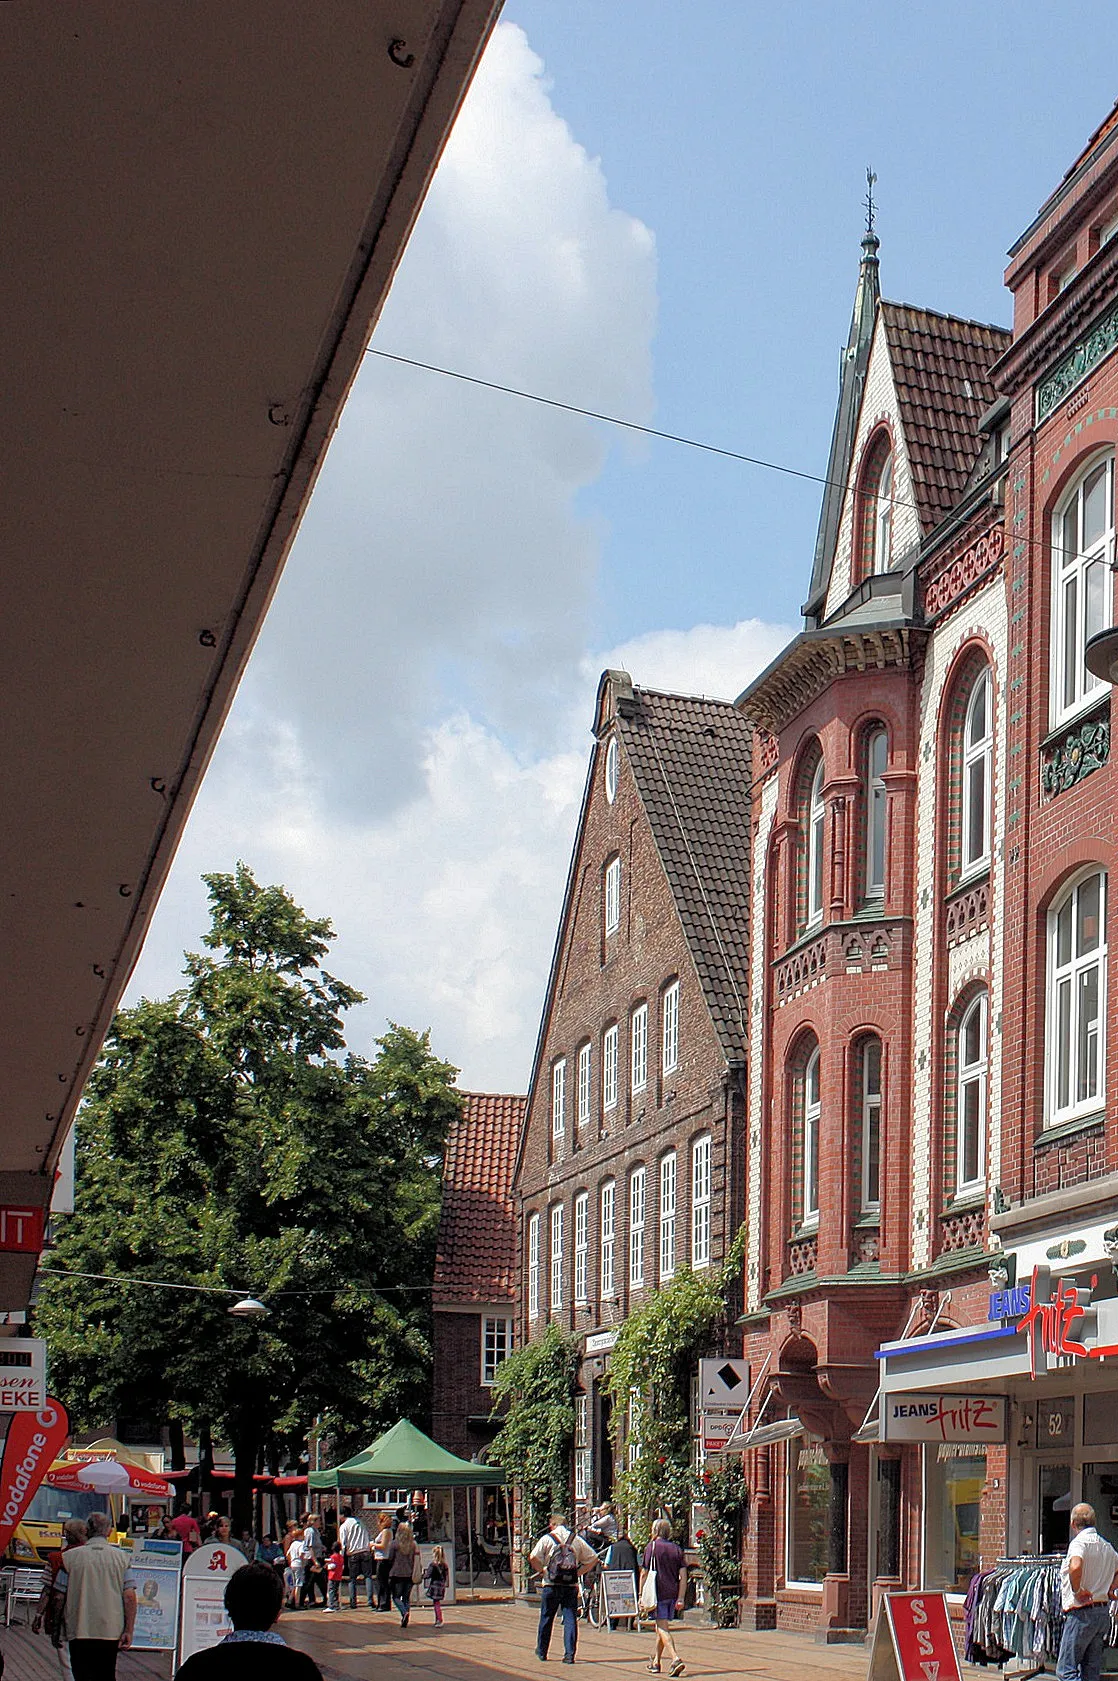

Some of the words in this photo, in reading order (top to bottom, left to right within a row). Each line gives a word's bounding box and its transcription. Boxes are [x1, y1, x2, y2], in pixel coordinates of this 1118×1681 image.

[988, 1285, 1031, 1321] JEANS
[1, 1391, 40, 1407] EKE
[893, 1402, 938, 1419] JEANS
[1048, 1413, 1063, 1436] 52
[0, 1432, 48, 1527] vodafone
[140, 1482, 167, 1491] vodafone
